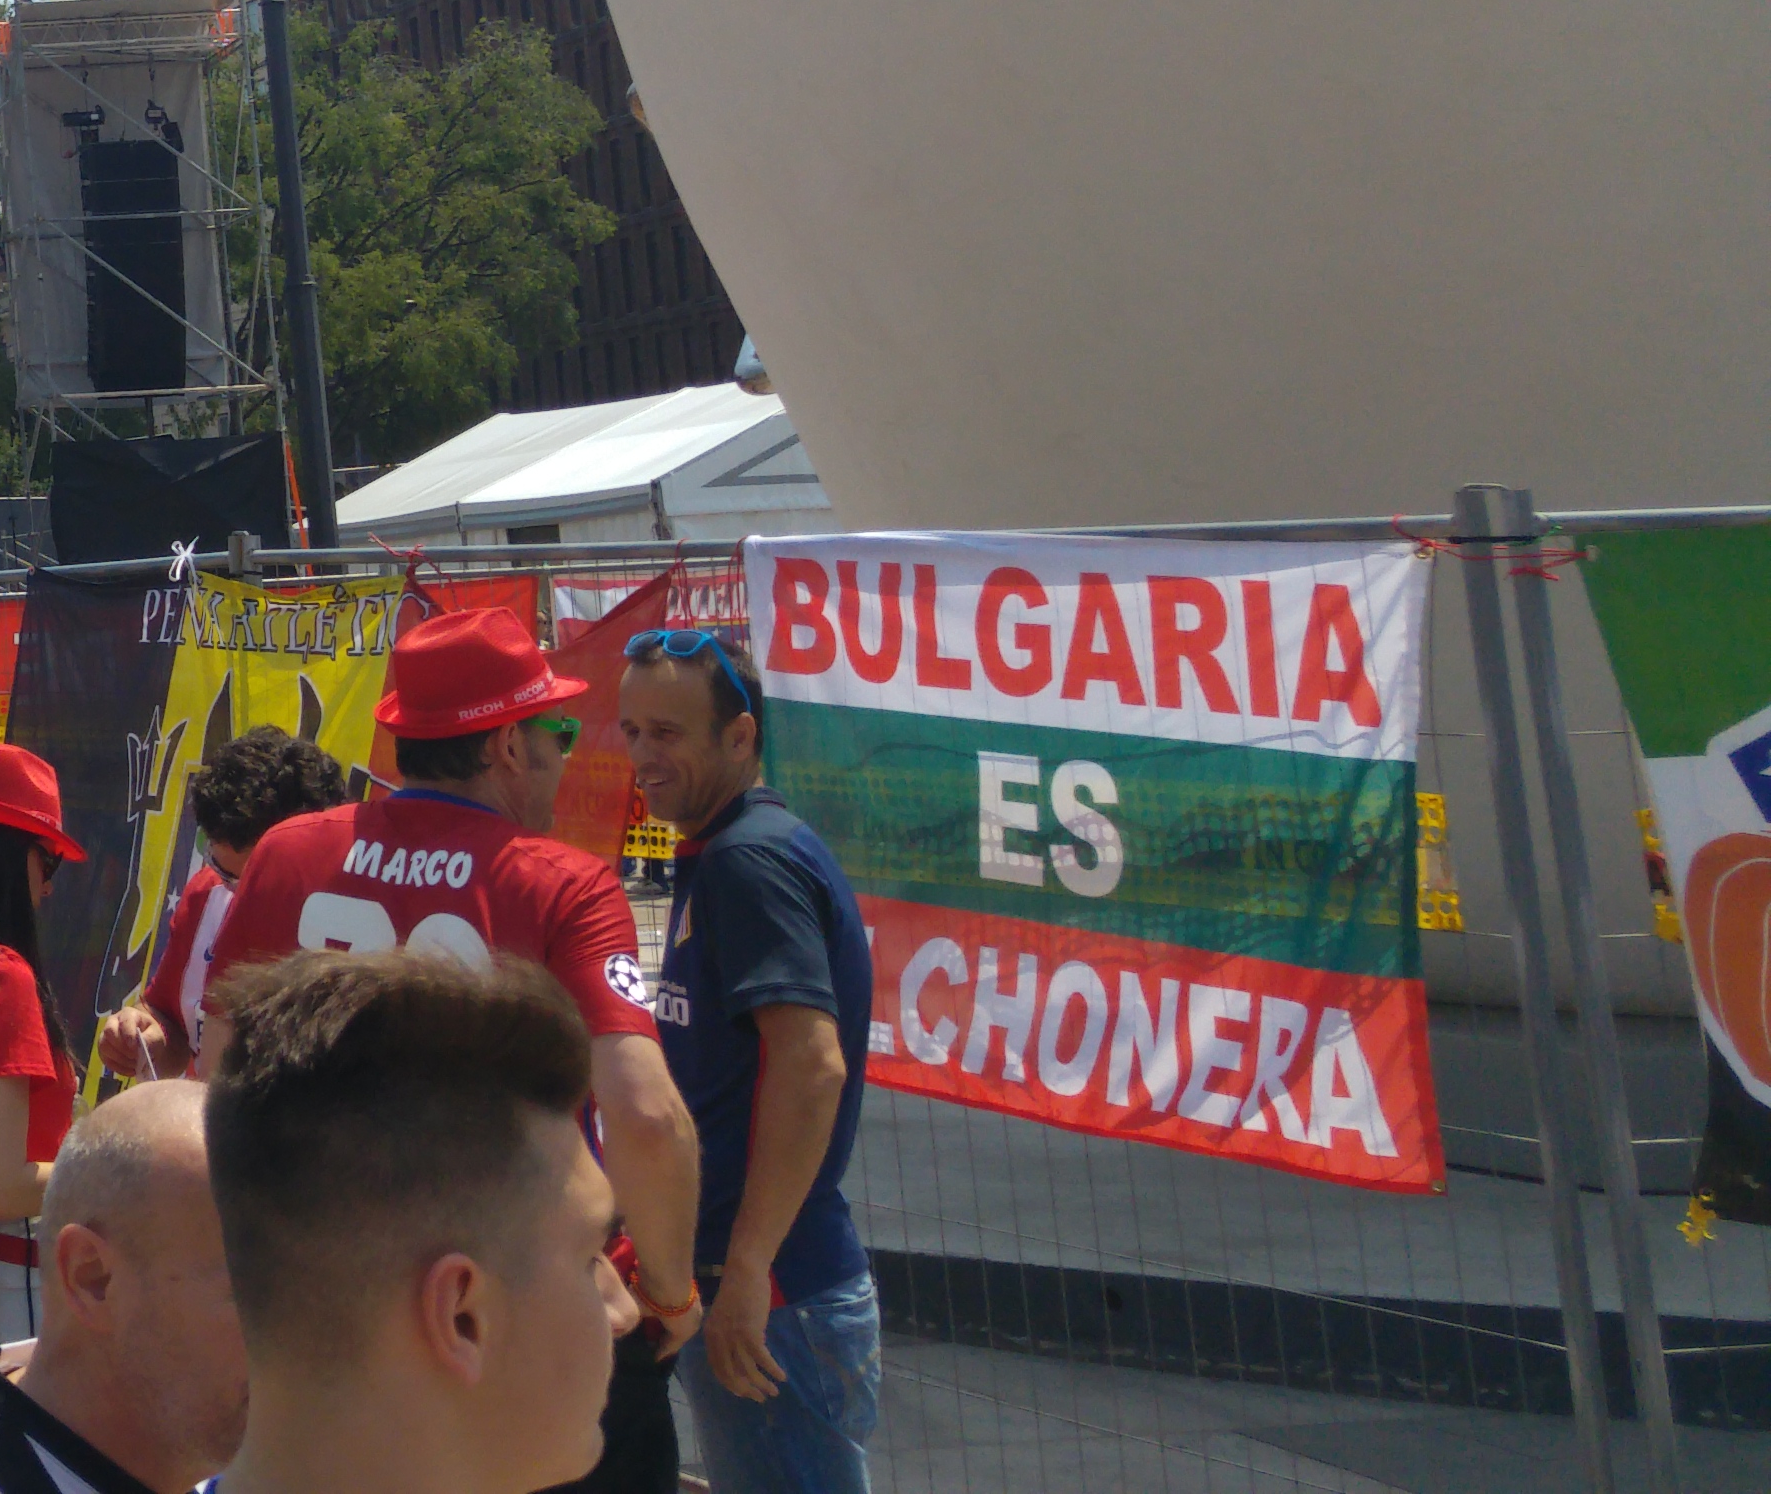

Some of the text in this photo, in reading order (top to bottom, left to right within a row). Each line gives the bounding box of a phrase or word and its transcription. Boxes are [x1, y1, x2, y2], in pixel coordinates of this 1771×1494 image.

[765, 557, 1382, 728] BULGARIA
[458, 700, 504, 720] RICOH
[514, 680, 546, 704] RICOH
[977, 751, 1126, 898] ES
[343, 839, 473, 889] MARCO
